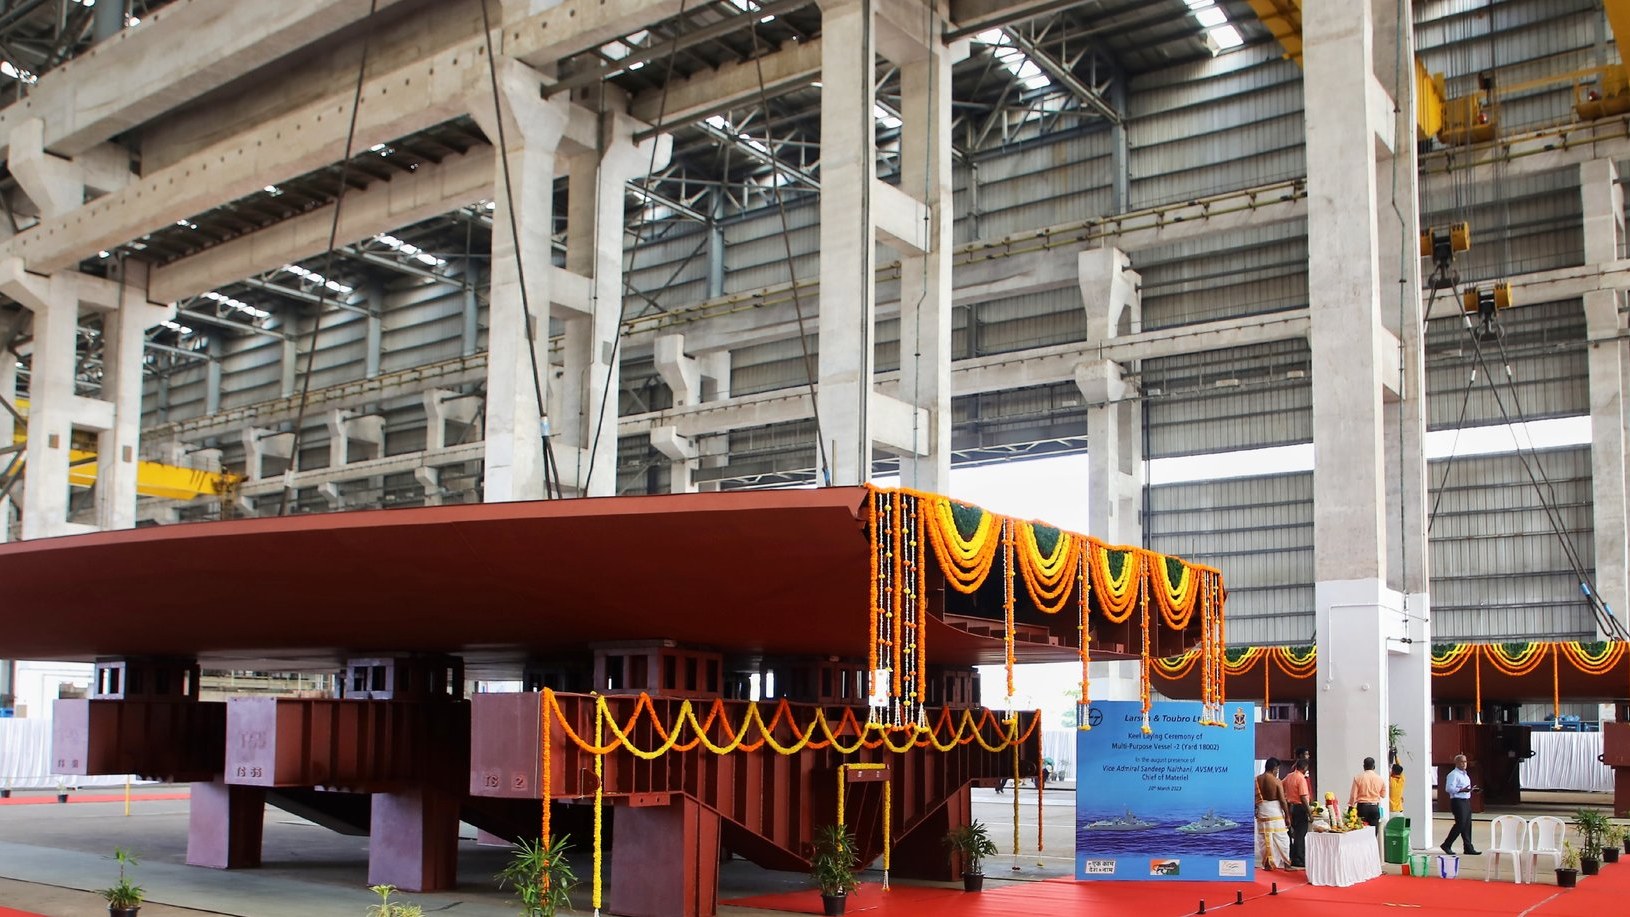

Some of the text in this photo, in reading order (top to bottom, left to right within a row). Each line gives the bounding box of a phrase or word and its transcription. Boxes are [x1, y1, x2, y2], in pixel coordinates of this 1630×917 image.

[1125, 714, 1151, 723] Lars
[1153, 714, 1160, 722] &
[1162, 714, 1191, 723] Toubro
[1164, 733, 1195, 741] Ceremony
[1111, 742, 1153, 751] Multi-Purpose
[1181, 743, 1198, 751] (Yard
[1200, 743, 1220, 751] 18002)
[1141, 765, 1166, 773] Sandeep
[485, 775, 525, 789] TS 2
